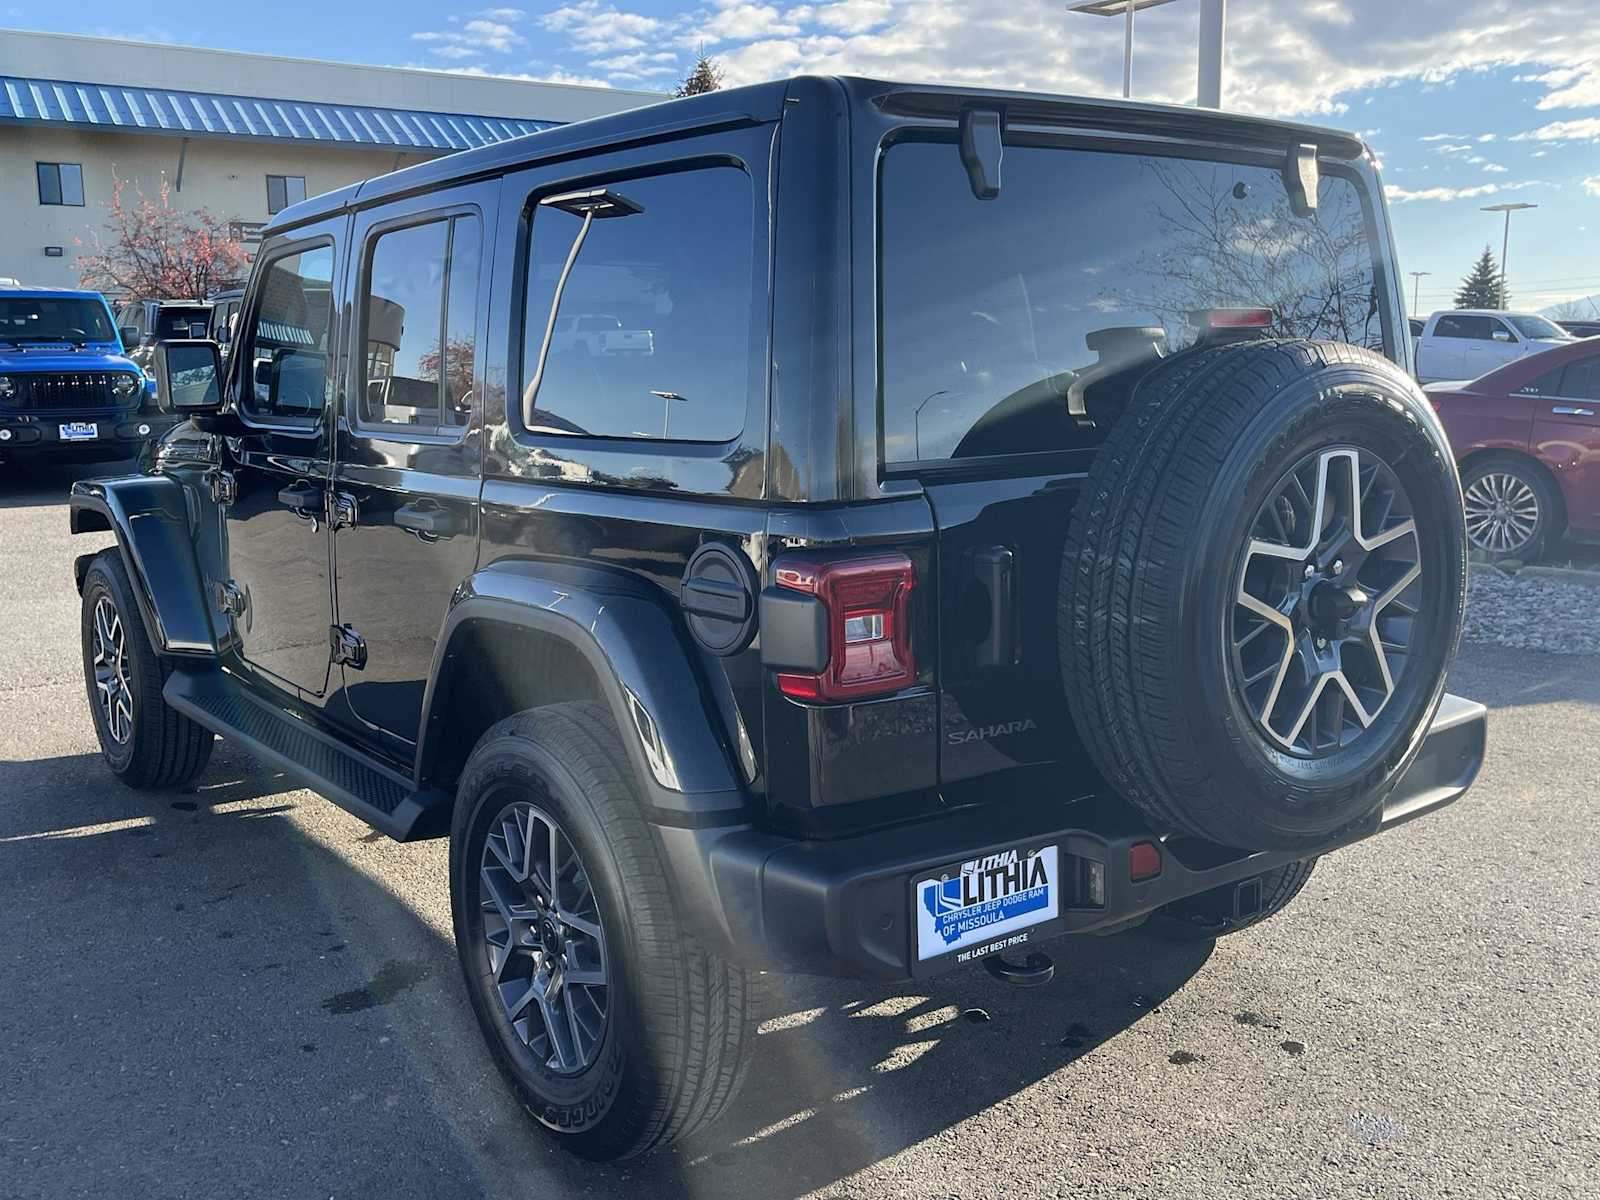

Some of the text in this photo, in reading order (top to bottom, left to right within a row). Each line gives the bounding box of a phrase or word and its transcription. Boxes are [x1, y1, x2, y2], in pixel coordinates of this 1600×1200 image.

[948, 719, 1037, 745] SAHARA
[974, 850, 1017, 872] LITHIA
[963, 857, 1048, 906] LITHIA
[943, 888, 1044, 924] CHRYSLER JEEP DODGE RAM
[943, 910, 1005, 937] OF MISSOULA
[957, 933, 1028, 962] THE LAST BEST PRICE
